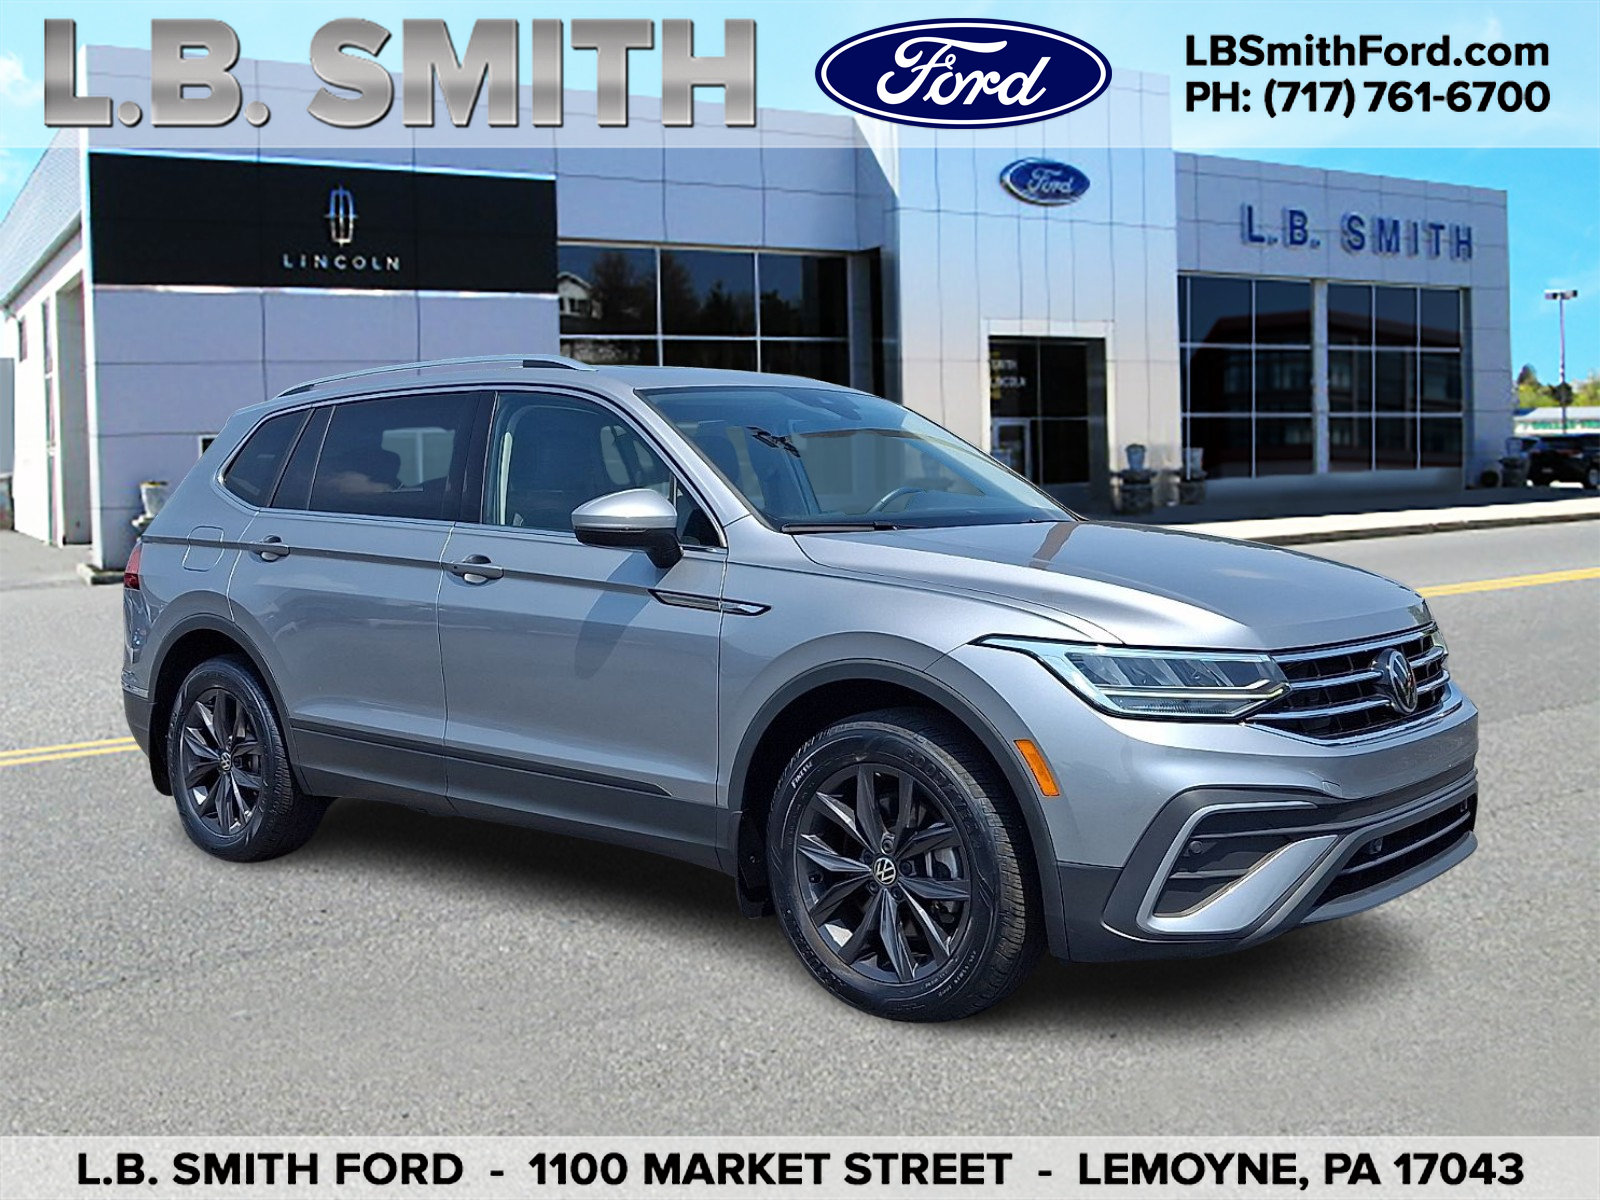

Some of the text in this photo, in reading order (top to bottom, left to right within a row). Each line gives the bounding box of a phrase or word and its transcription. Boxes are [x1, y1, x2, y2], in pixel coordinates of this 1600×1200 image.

[1027, 166, 1075, 194] Ford
[1240, 203, 1474, 262] L.B. SMITH
[282, 253, 400, 271] LINCOLN
